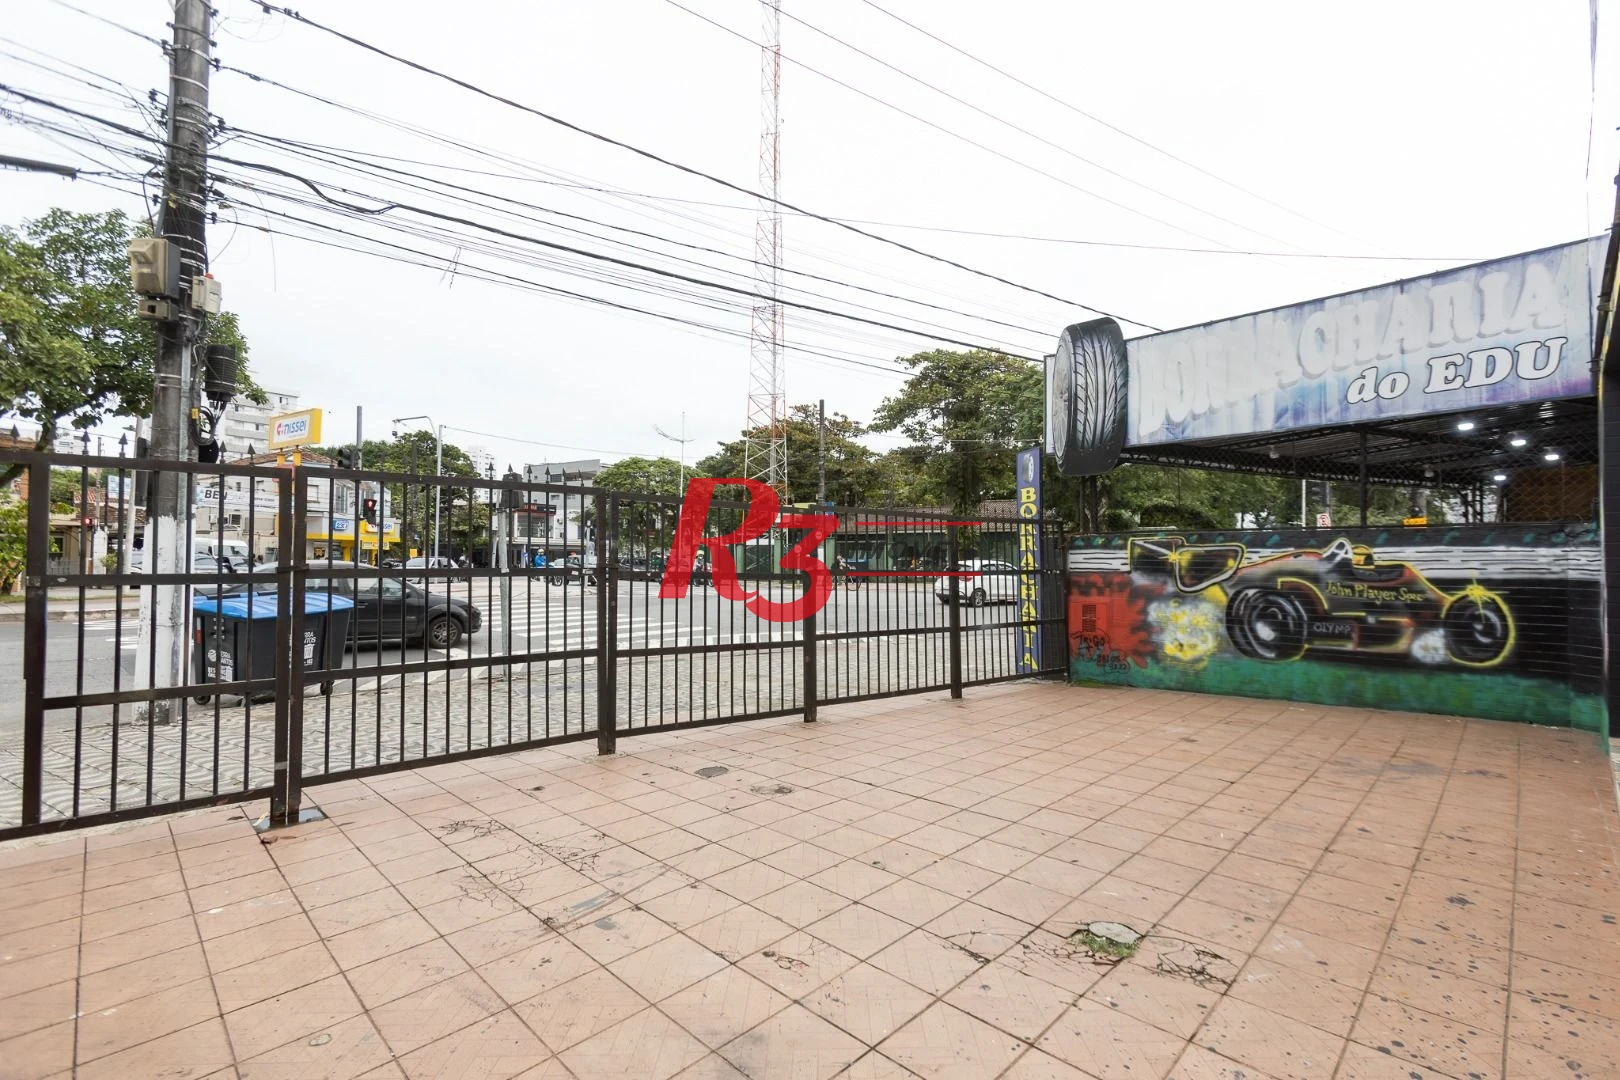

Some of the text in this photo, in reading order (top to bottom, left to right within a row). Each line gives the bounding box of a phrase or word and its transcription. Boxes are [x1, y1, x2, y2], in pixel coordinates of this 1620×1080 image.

[1346, 336, 1569, 405] do EDU
[1020, 486, 1038, 671] BORRACHARIA
[1325, 581, 1353, 598] John
[1354, 584, 1397, 605] Player
